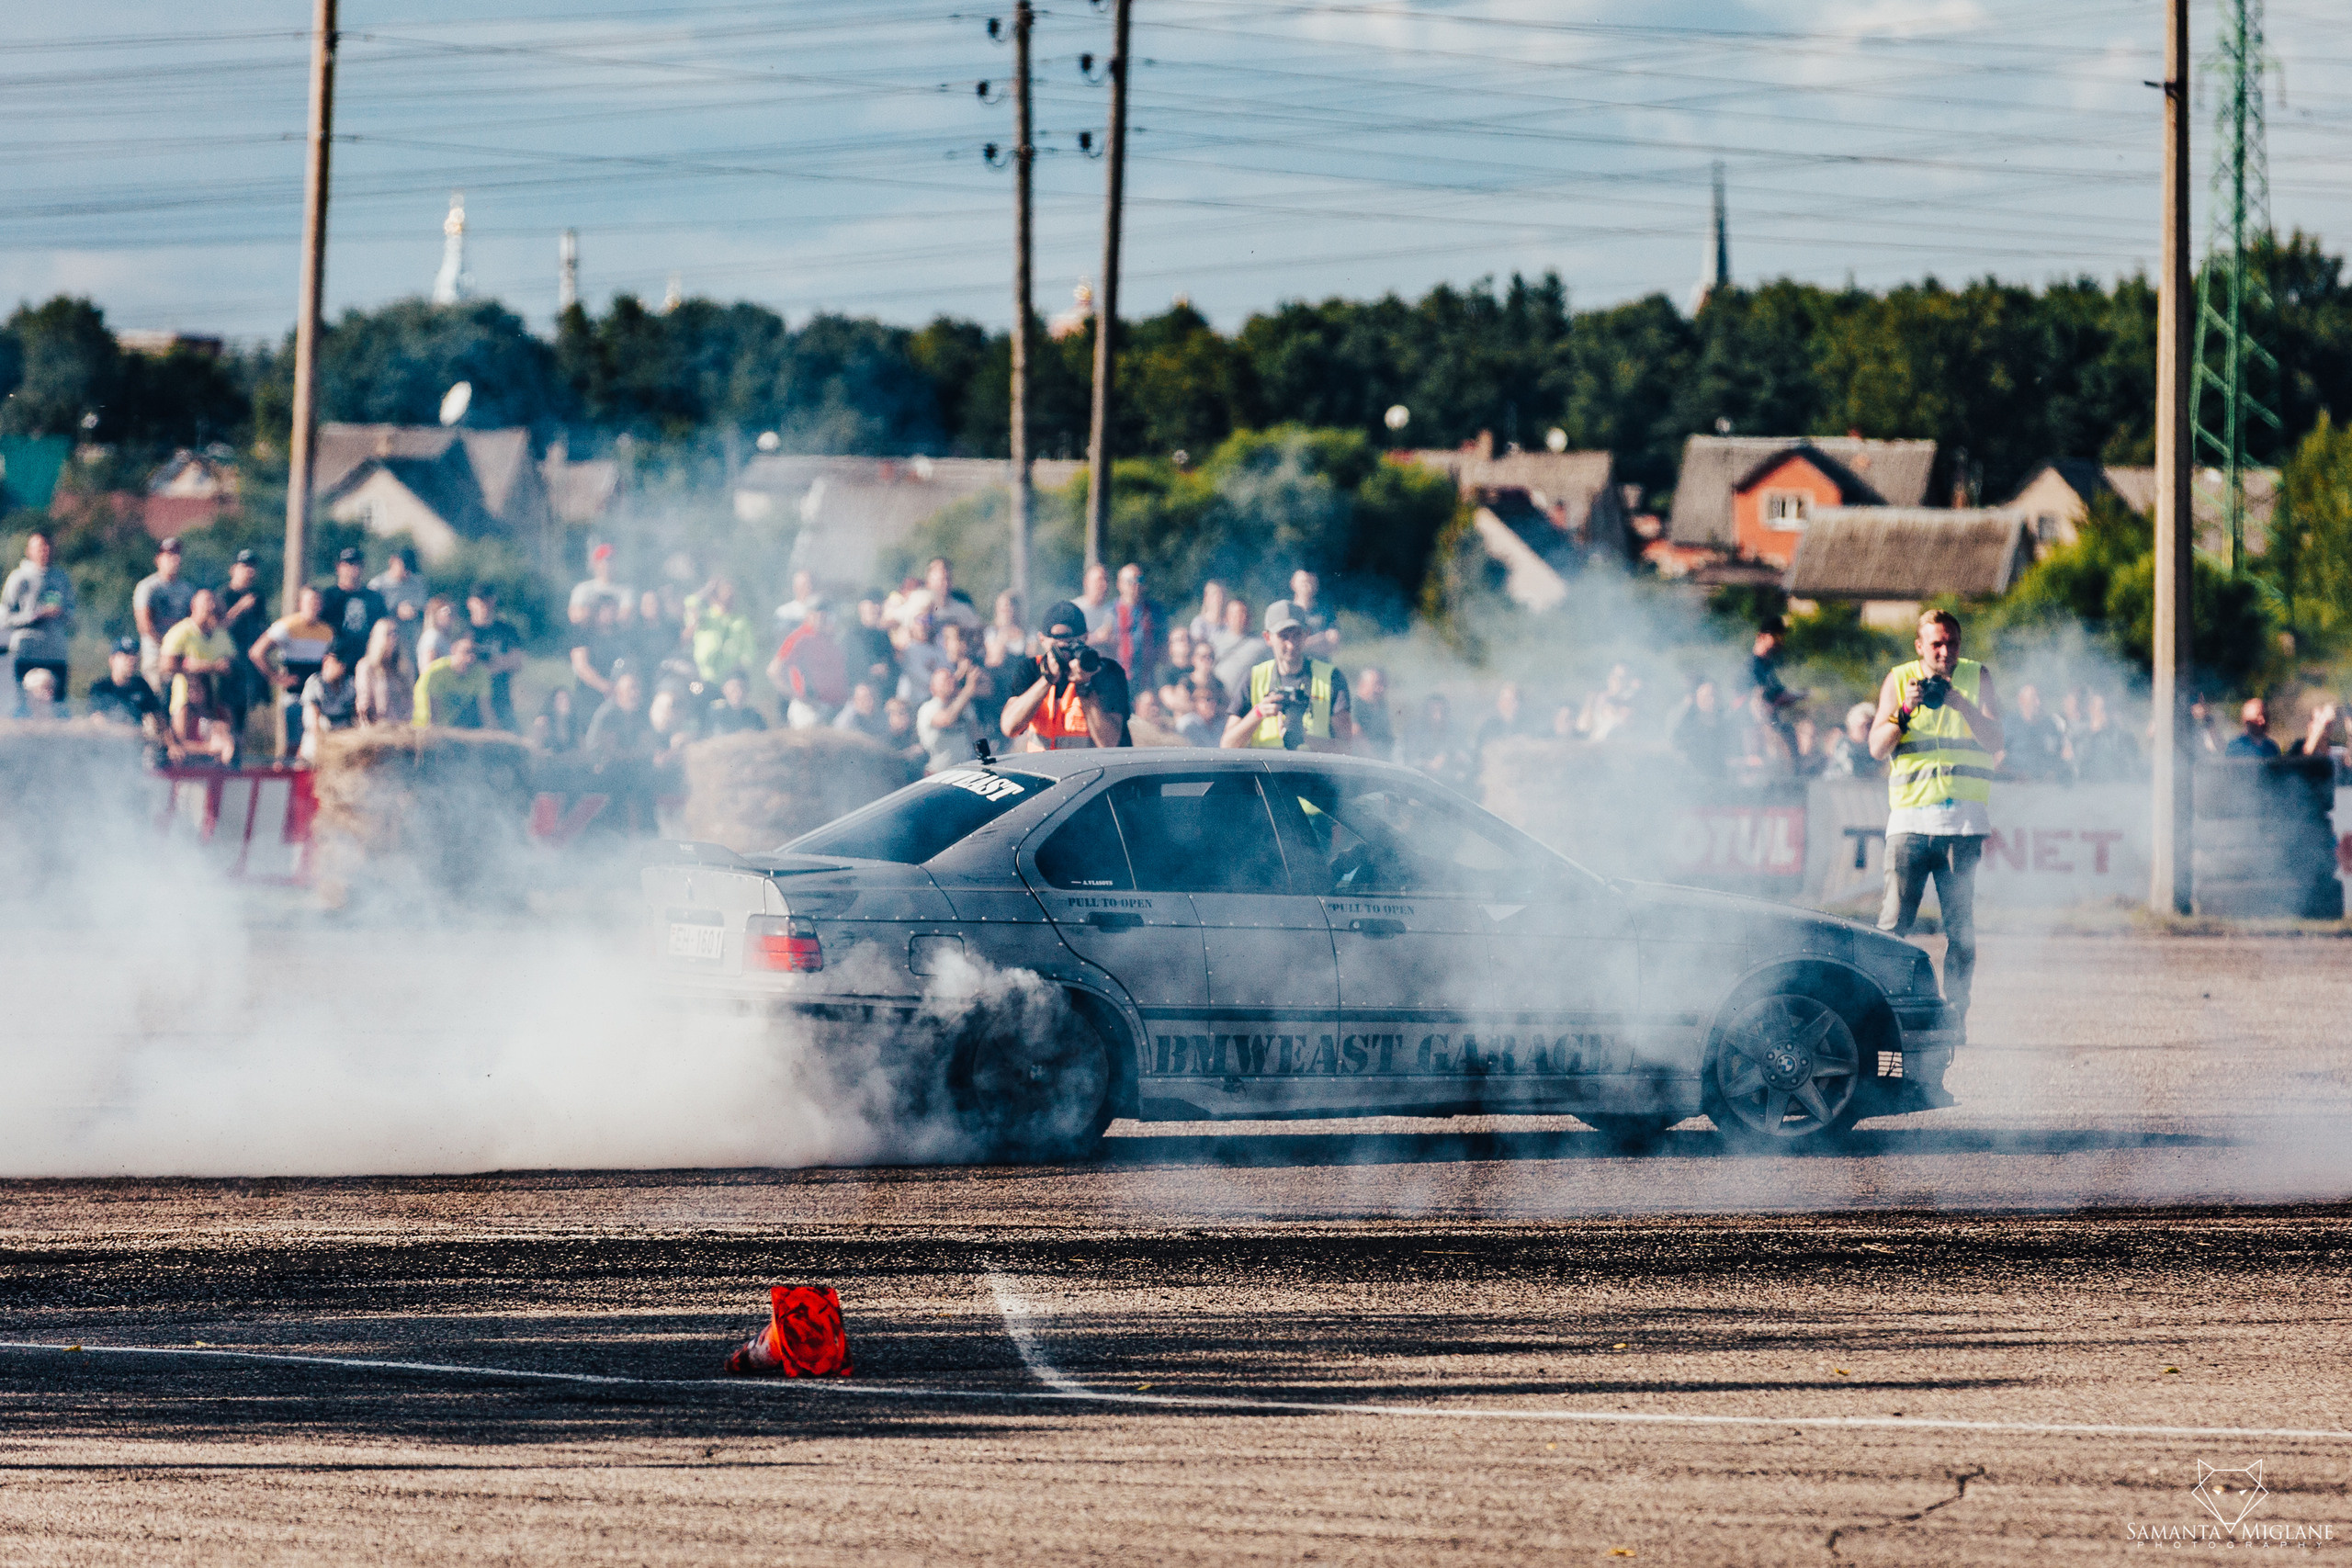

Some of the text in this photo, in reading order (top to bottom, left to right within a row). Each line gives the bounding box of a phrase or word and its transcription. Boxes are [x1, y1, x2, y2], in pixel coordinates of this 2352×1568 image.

[1068, 897, 1153, 908] PULL TO OPEN
[1328, 903, 1415, 916] PULL TO OPEN
[1154, 1033, 1615, 1074] BMWEAST GARAGE
